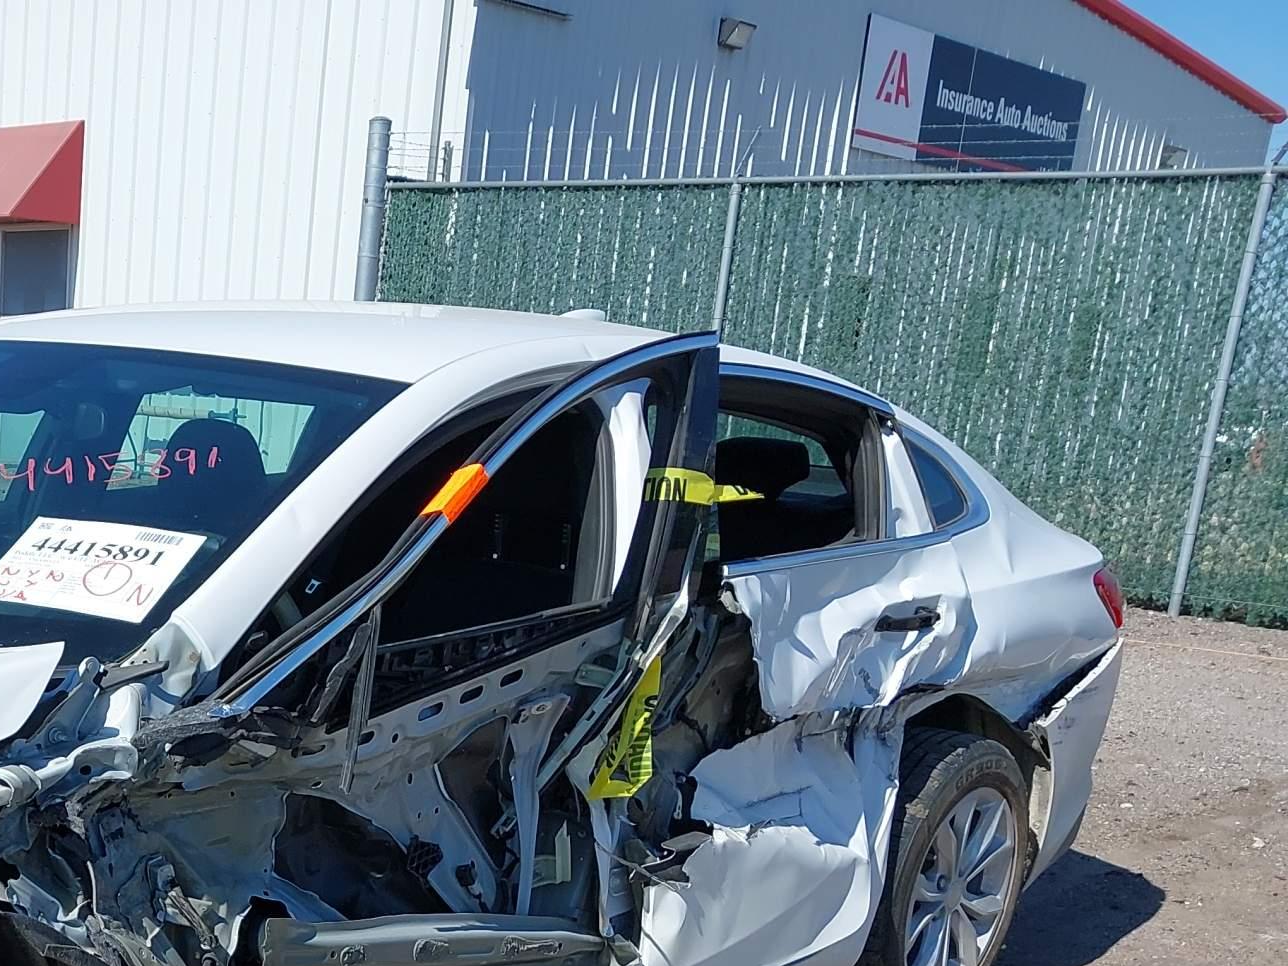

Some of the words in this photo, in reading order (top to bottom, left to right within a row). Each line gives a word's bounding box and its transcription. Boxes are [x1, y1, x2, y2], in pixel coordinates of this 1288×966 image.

[936, 79, 994, 121] Insurance
[994, 97, 1021, 129] Auto
[1021, 104, 1069, 141] Auctions
[31, 537, 166, 566] 44415891
[126, 584, 154, 606] N
